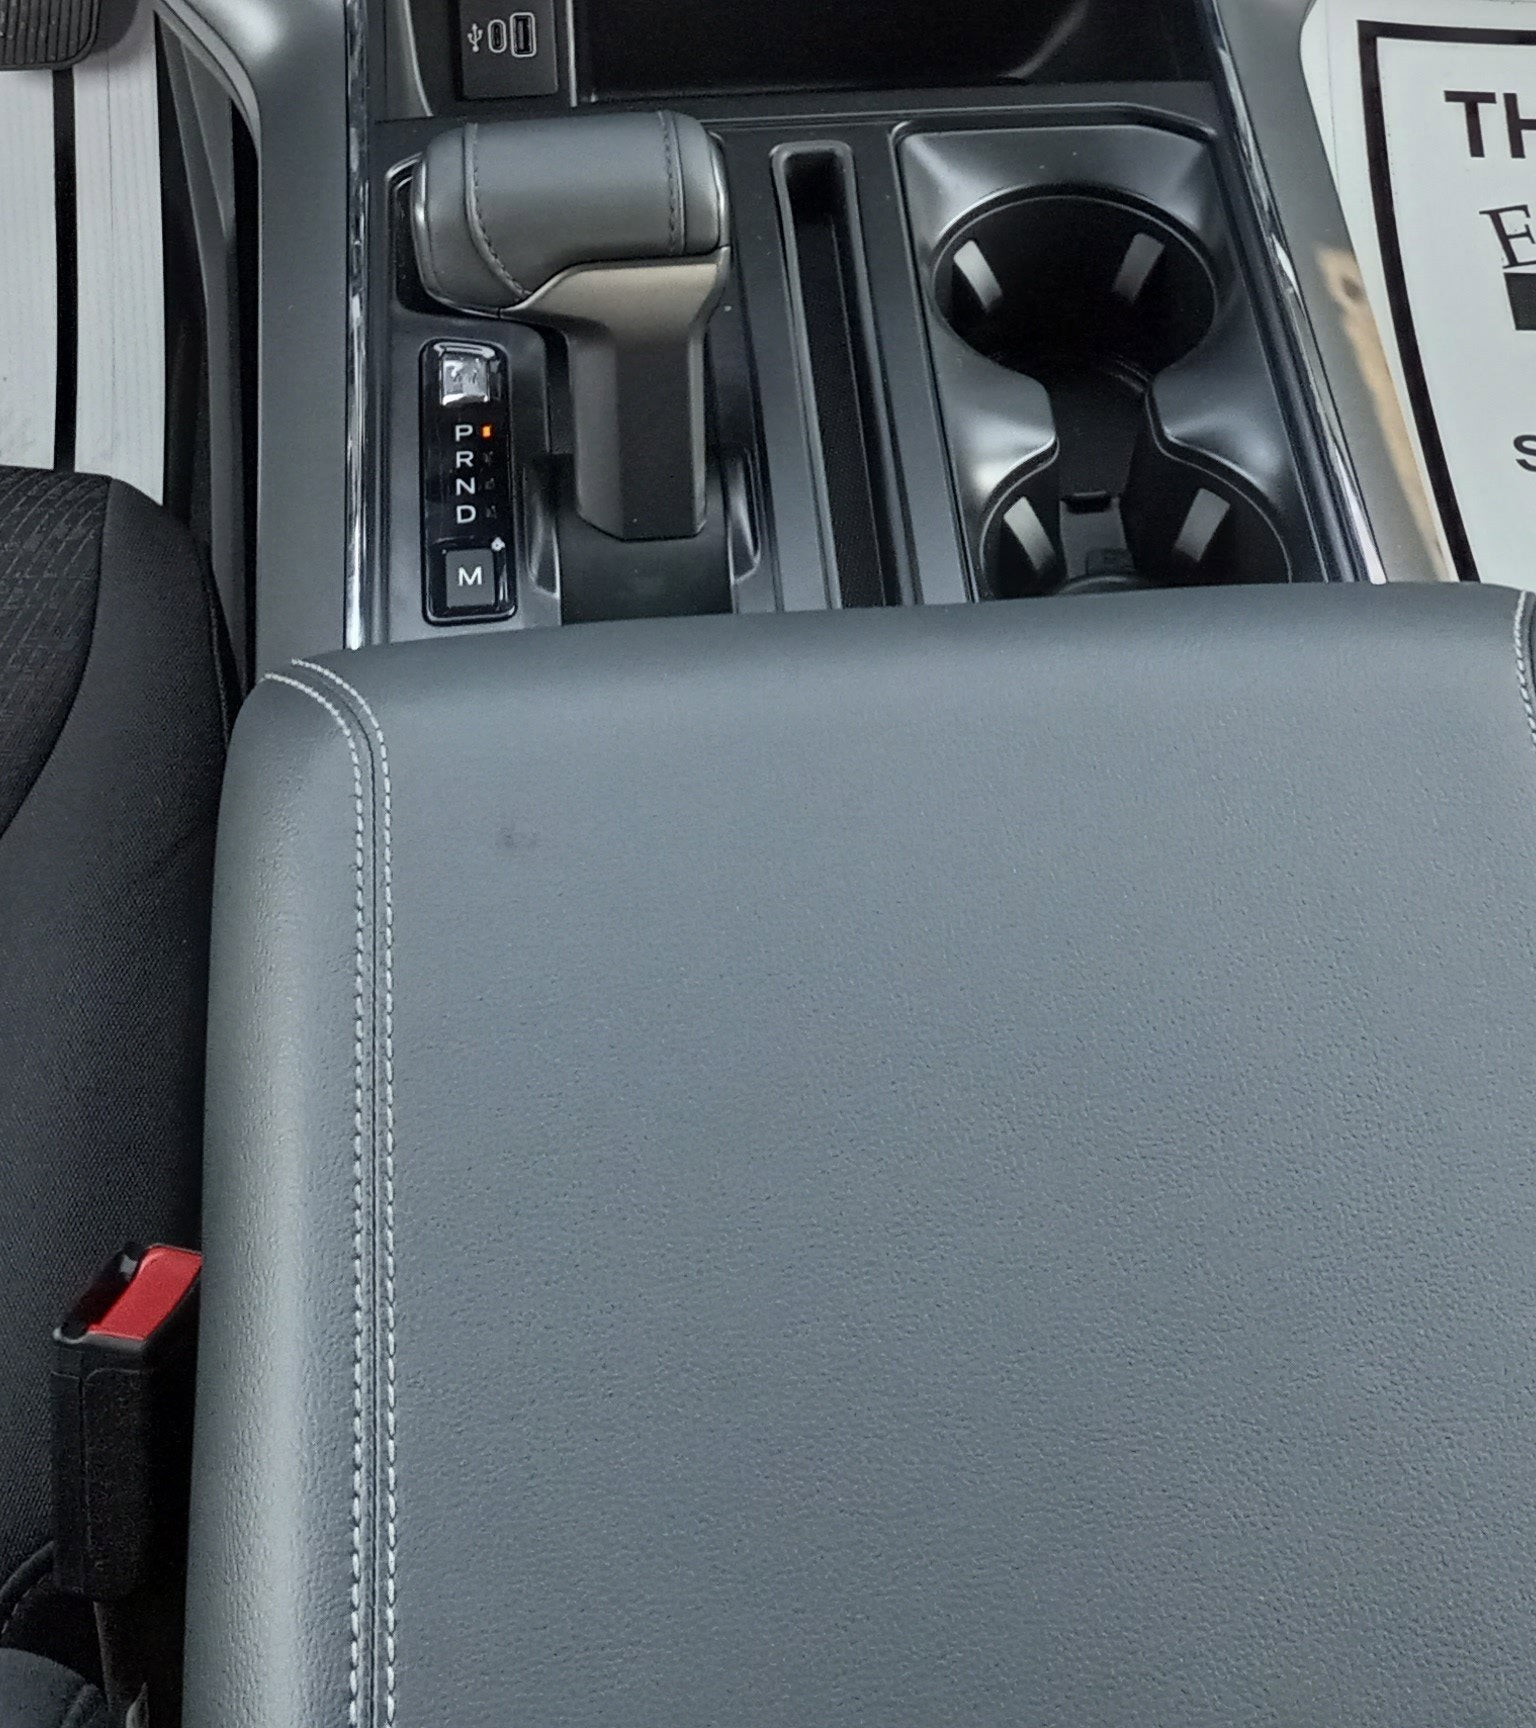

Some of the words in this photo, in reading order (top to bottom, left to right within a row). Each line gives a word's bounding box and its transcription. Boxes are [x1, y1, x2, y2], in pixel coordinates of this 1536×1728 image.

[454, 424, 473, 443] P
[455, 451, 475, 469] R
[455, 477, 476, 496] N
[456, 504, 477, 524] D
[457, 566, 483, 587] M
